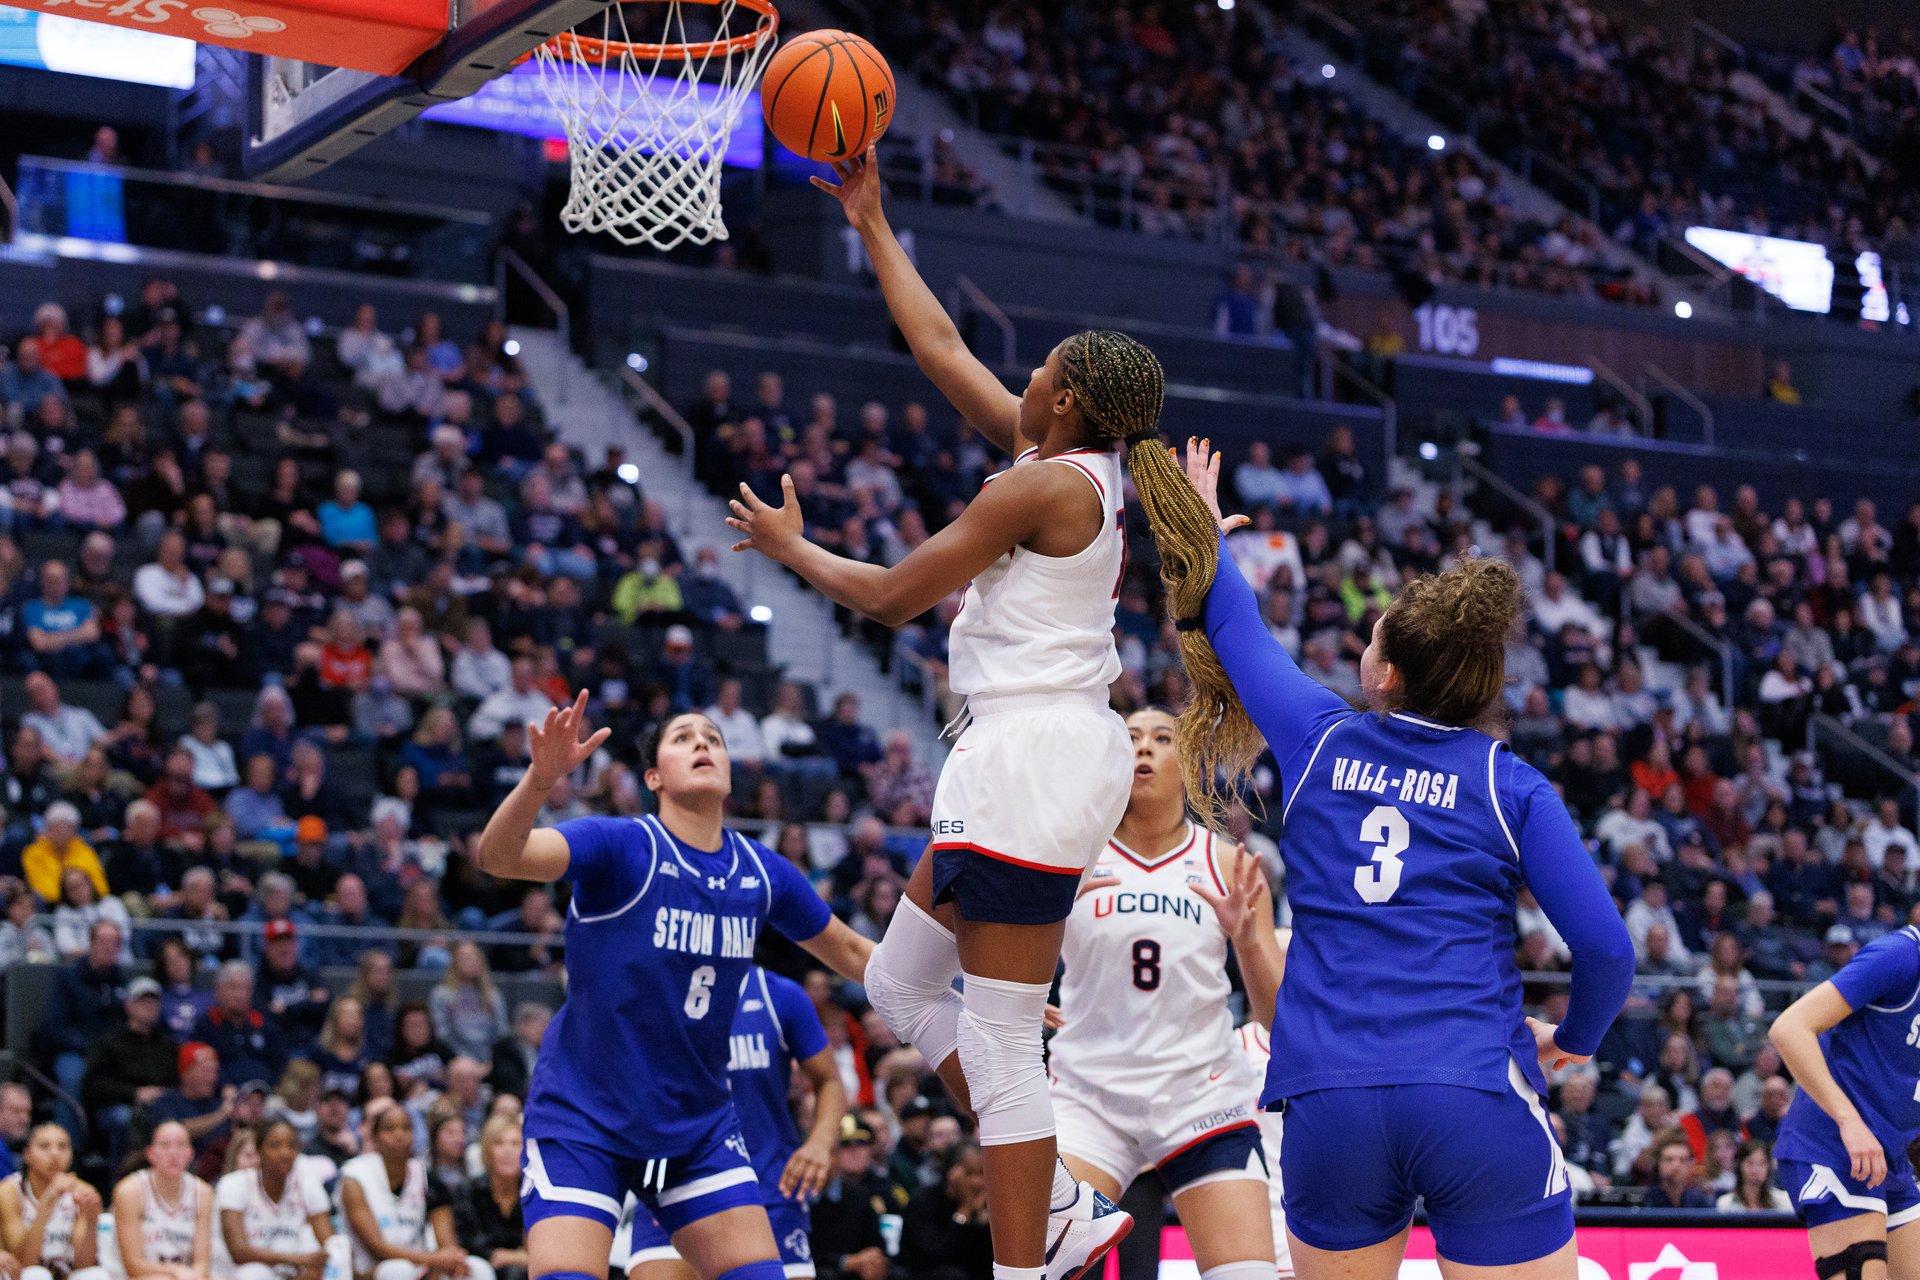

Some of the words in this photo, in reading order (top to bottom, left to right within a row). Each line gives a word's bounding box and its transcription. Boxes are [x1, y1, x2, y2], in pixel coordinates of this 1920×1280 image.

[1413, 302, 1480, 357] 105
[1332, 757, 1459, 810] HALL-ROSA
[1353, 805, 1410, 904] 3
[653, 906, 715, 956] SETON
[1094, 892, 1201, 925] UCONN
[1132, 939, 1161, 992] 8
[684, 965, 717, 1020] 6
